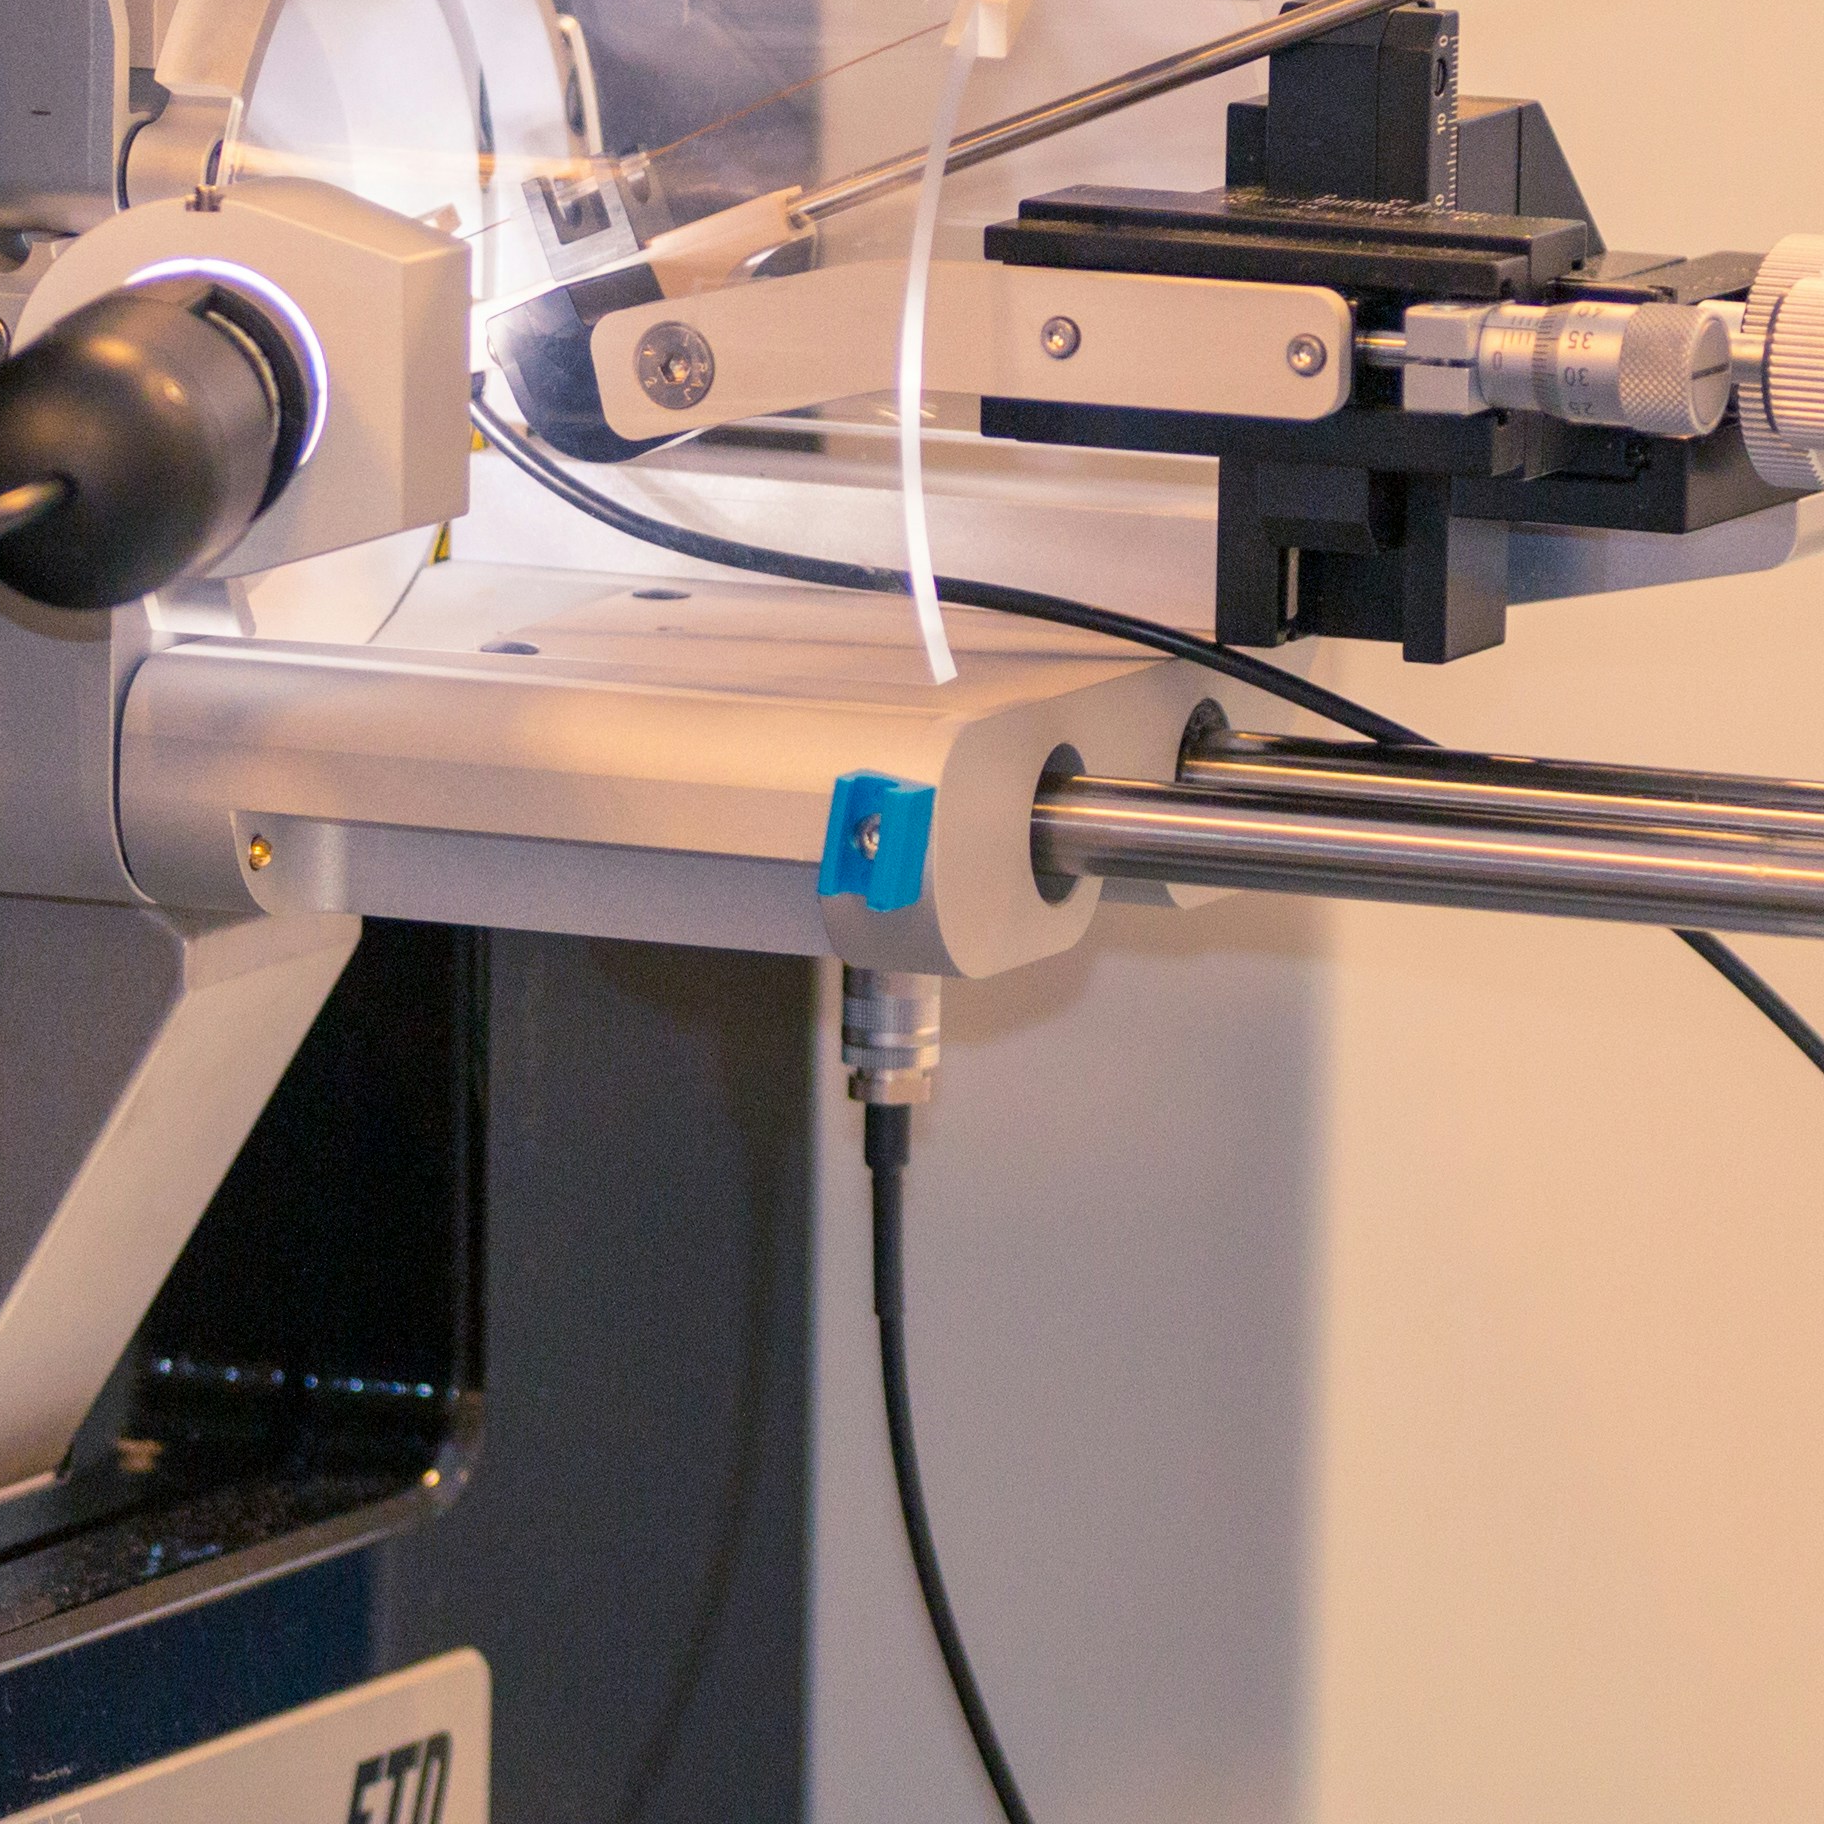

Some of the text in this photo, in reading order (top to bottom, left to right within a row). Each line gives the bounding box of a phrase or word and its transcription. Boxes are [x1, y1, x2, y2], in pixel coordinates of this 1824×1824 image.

[1436, 113, 1447, 135] 10
[1567, 330, 1594, 350] 35
[1563, 366, 1590, 387] 30
